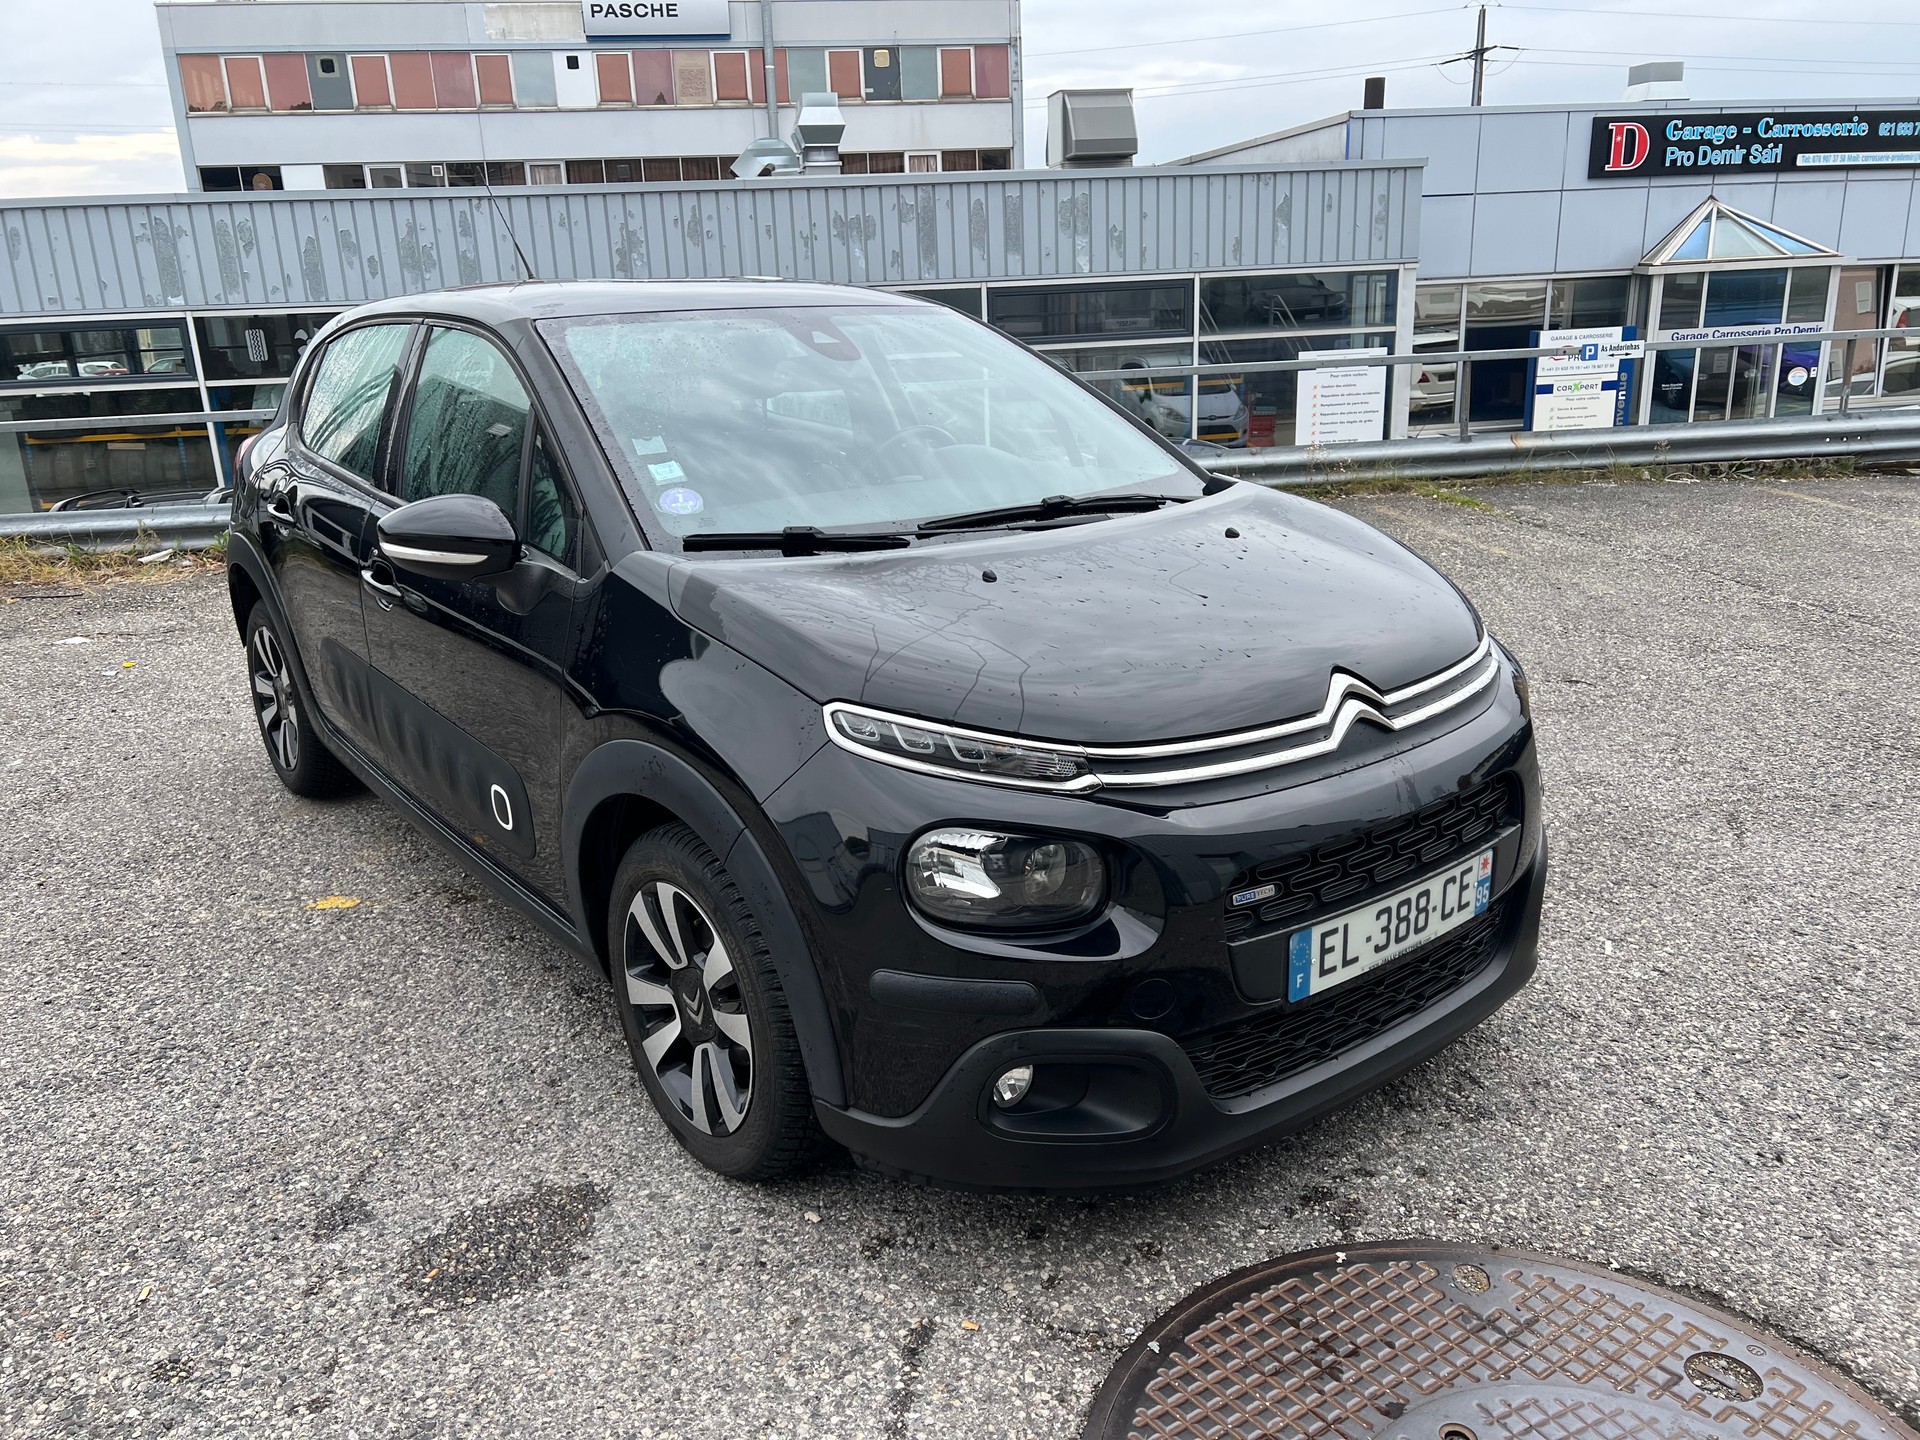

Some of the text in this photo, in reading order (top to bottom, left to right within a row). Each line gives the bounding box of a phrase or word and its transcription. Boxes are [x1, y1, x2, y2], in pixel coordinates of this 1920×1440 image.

[590, 3, 679, 18] PASCHE
[1666, 119, 1738, 144] Garage
[1757, 116, 1869, 138] Carrosserie
[1604, 122, 1650, 171] D
[1665, 147, 1694, 167] Pro
[1698, 145, 1746, 166] Demir
[1774, 327, 1791, 336] Pro
[1601, 342, 1640, 352] As Andorinhas
[1475, 880, 1490, 908] 95
[1296, 973, 1304, 988] F
